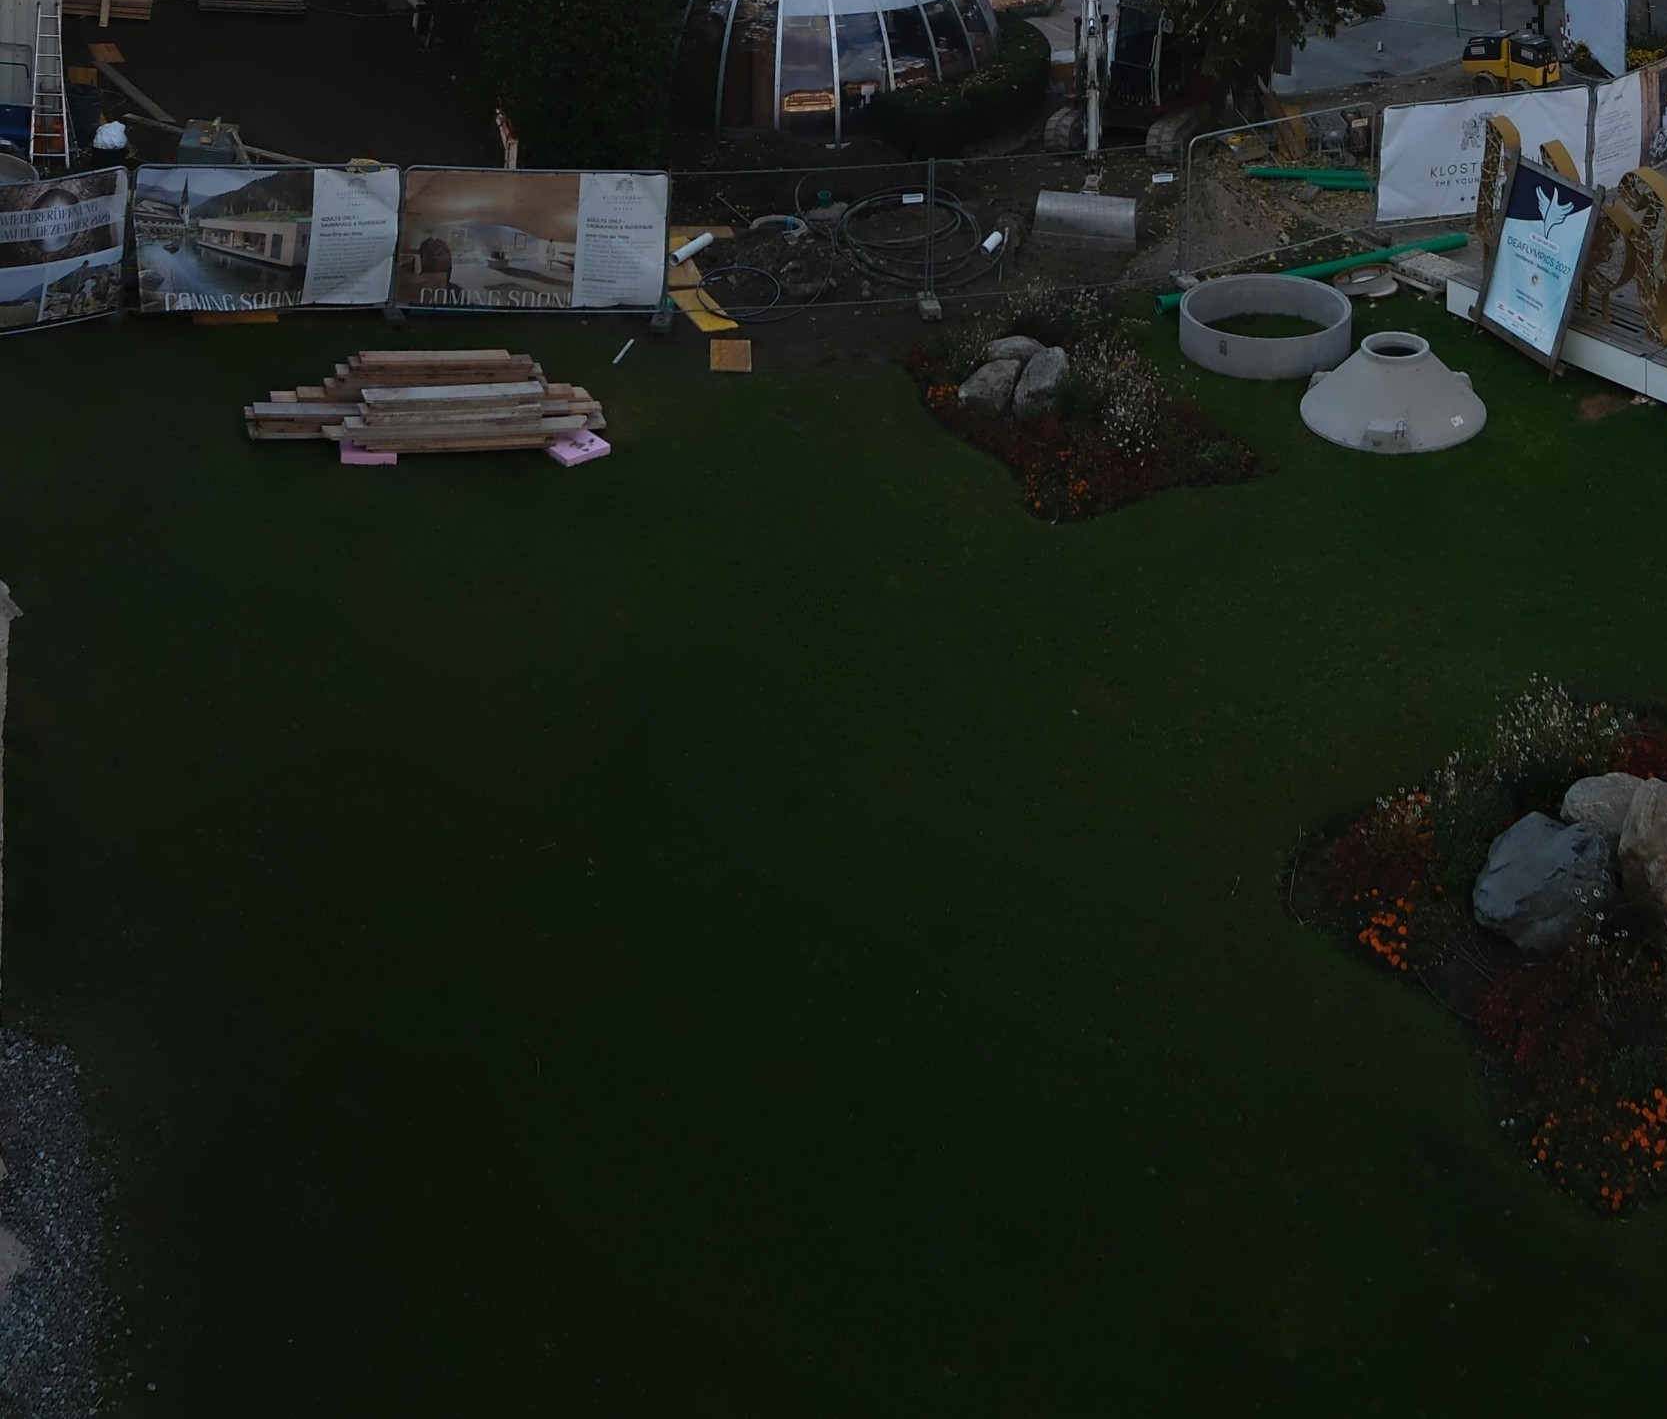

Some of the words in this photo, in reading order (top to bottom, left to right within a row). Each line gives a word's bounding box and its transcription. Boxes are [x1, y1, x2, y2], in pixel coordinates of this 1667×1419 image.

[1430, 161, 1487, 178] KLOST
[1435, 180, 1451, 188] THE
[1456, 177, 1480, 185] YOUN
[0, 202, 98, 226] WIEDERERÖFFNUNG
[36, 219, 89, 237] DEZEMBER
[1507, 236, 1555, 267] DEAFLYMPICS
[1555, 261, 1571, 276] 2027
[164, 292, 235, 311] COMING
[419, 287, 501, 306] COMING
